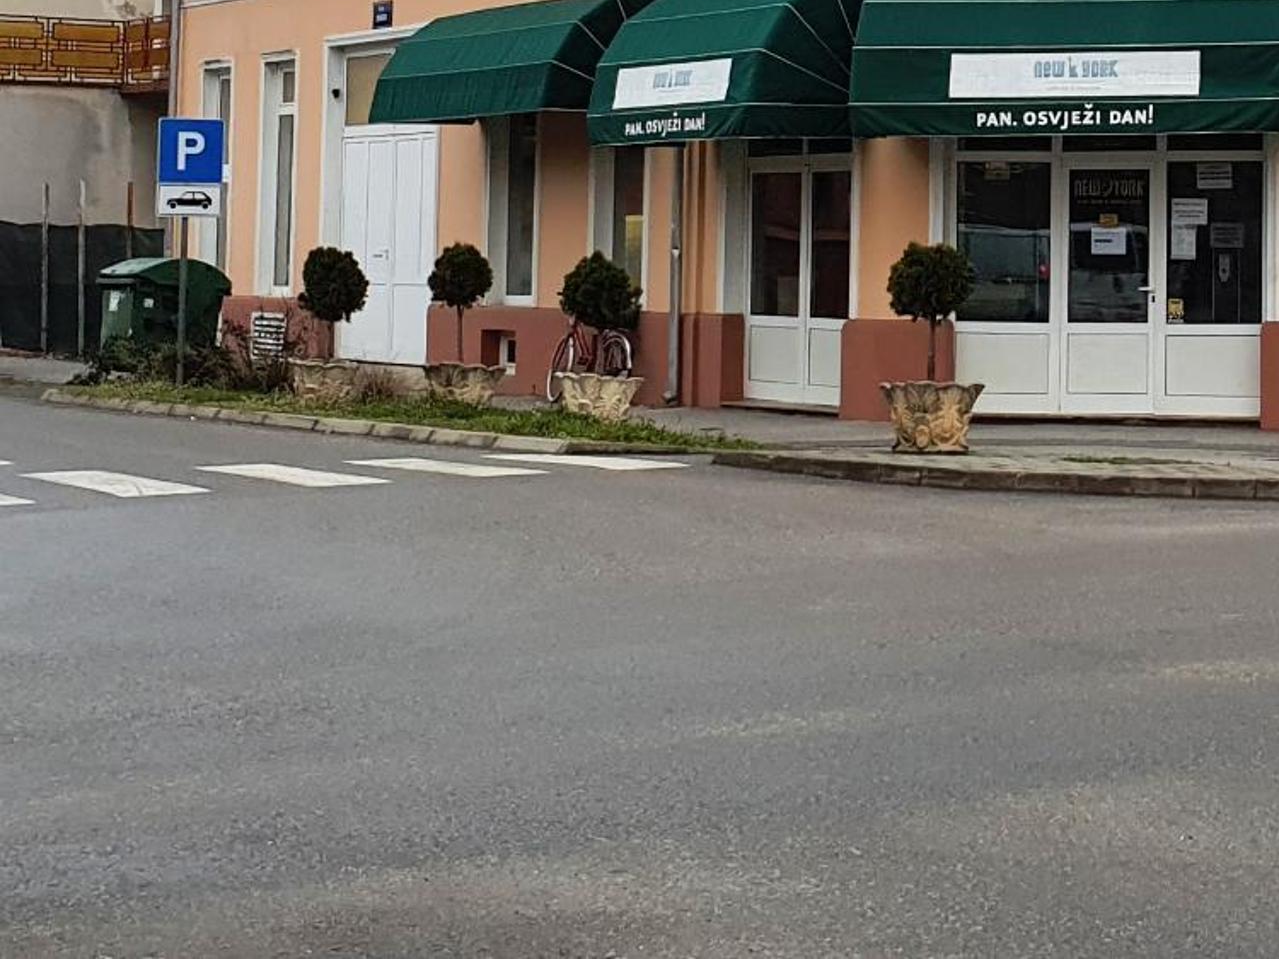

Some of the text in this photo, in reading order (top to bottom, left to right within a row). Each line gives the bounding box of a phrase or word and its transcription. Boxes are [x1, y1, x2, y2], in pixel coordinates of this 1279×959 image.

[976, 103, 1154, 130] PAN. OSVJEŽI DAN!
[176, 131, 206, 171] P
